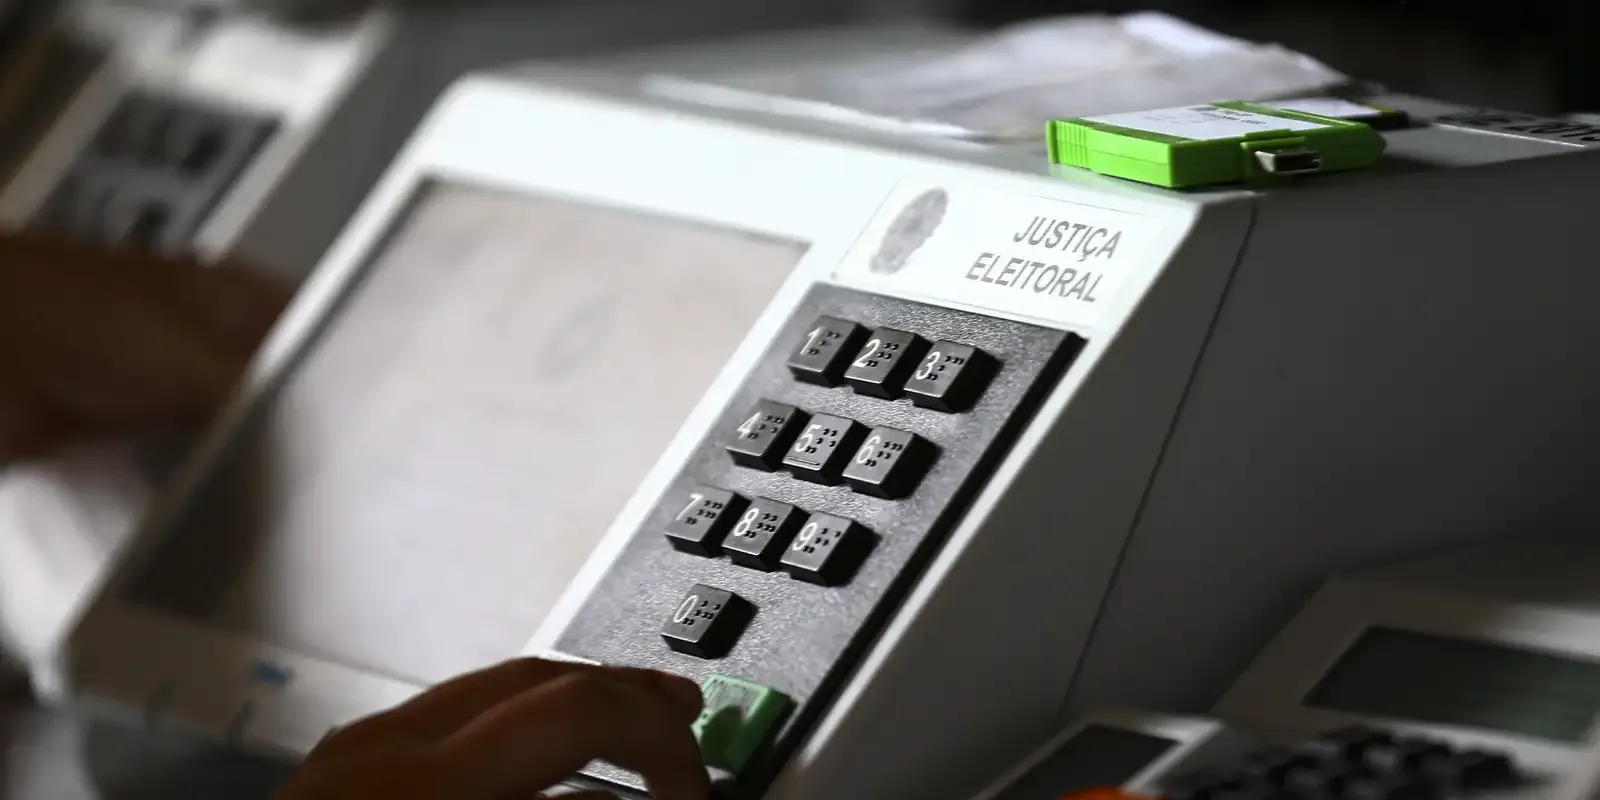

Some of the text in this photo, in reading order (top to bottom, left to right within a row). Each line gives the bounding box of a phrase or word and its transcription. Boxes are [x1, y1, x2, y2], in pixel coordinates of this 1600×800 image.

[1013, 216, 1123, 262] JUSTIÇA
[965, 252, 1103, 302] ELEITORAL
[800, 326, 823, 355] 1
[852, 339, 880, 368] 2
[915, 351, 941, 380] 3
[737, 412, 762, 439] 4
[795, 425, 821, 452] 5
[856, 435, 880, 464] 6
[675, 493, 704, 520] 7
[734, 508, 759, 536] 8
[793, 522, 818, 551] 9
[673, 595, 698, 623] 0
